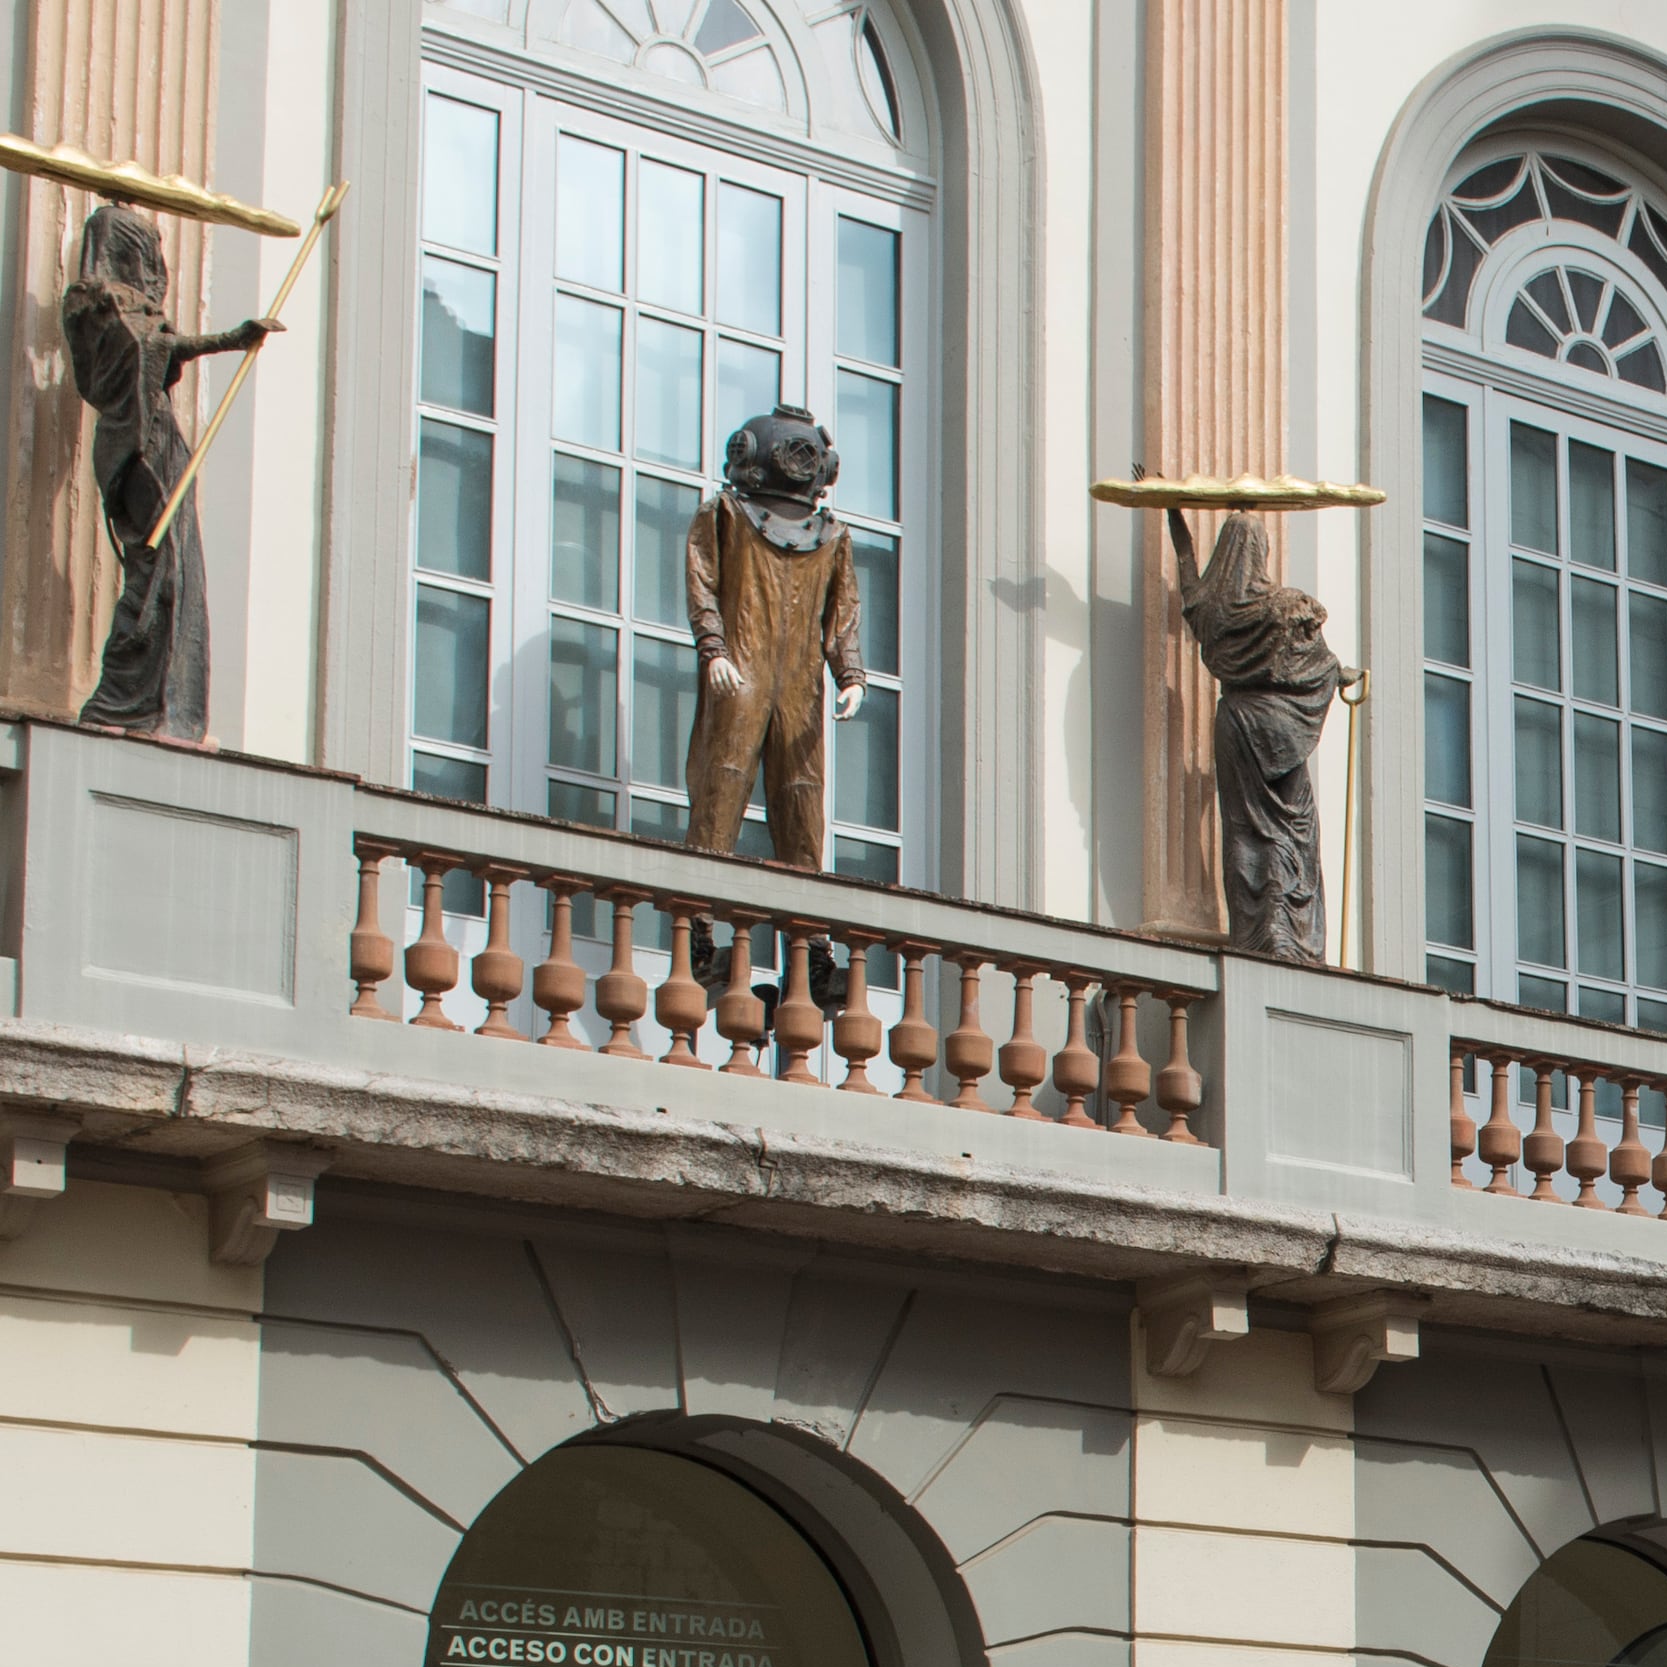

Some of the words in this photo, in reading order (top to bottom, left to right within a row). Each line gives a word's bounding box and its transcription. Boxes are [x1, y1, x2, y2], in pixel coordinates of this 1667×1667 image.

[459, 1599, 556, 1626] ACCÉS
[562, 1606, 625, 1631] AMB
[632, 1611, 766, 1640] ENTRADA
[447, 1635, 567, 1664] ACCESO
[574, 1642, 634, 1667] CON
